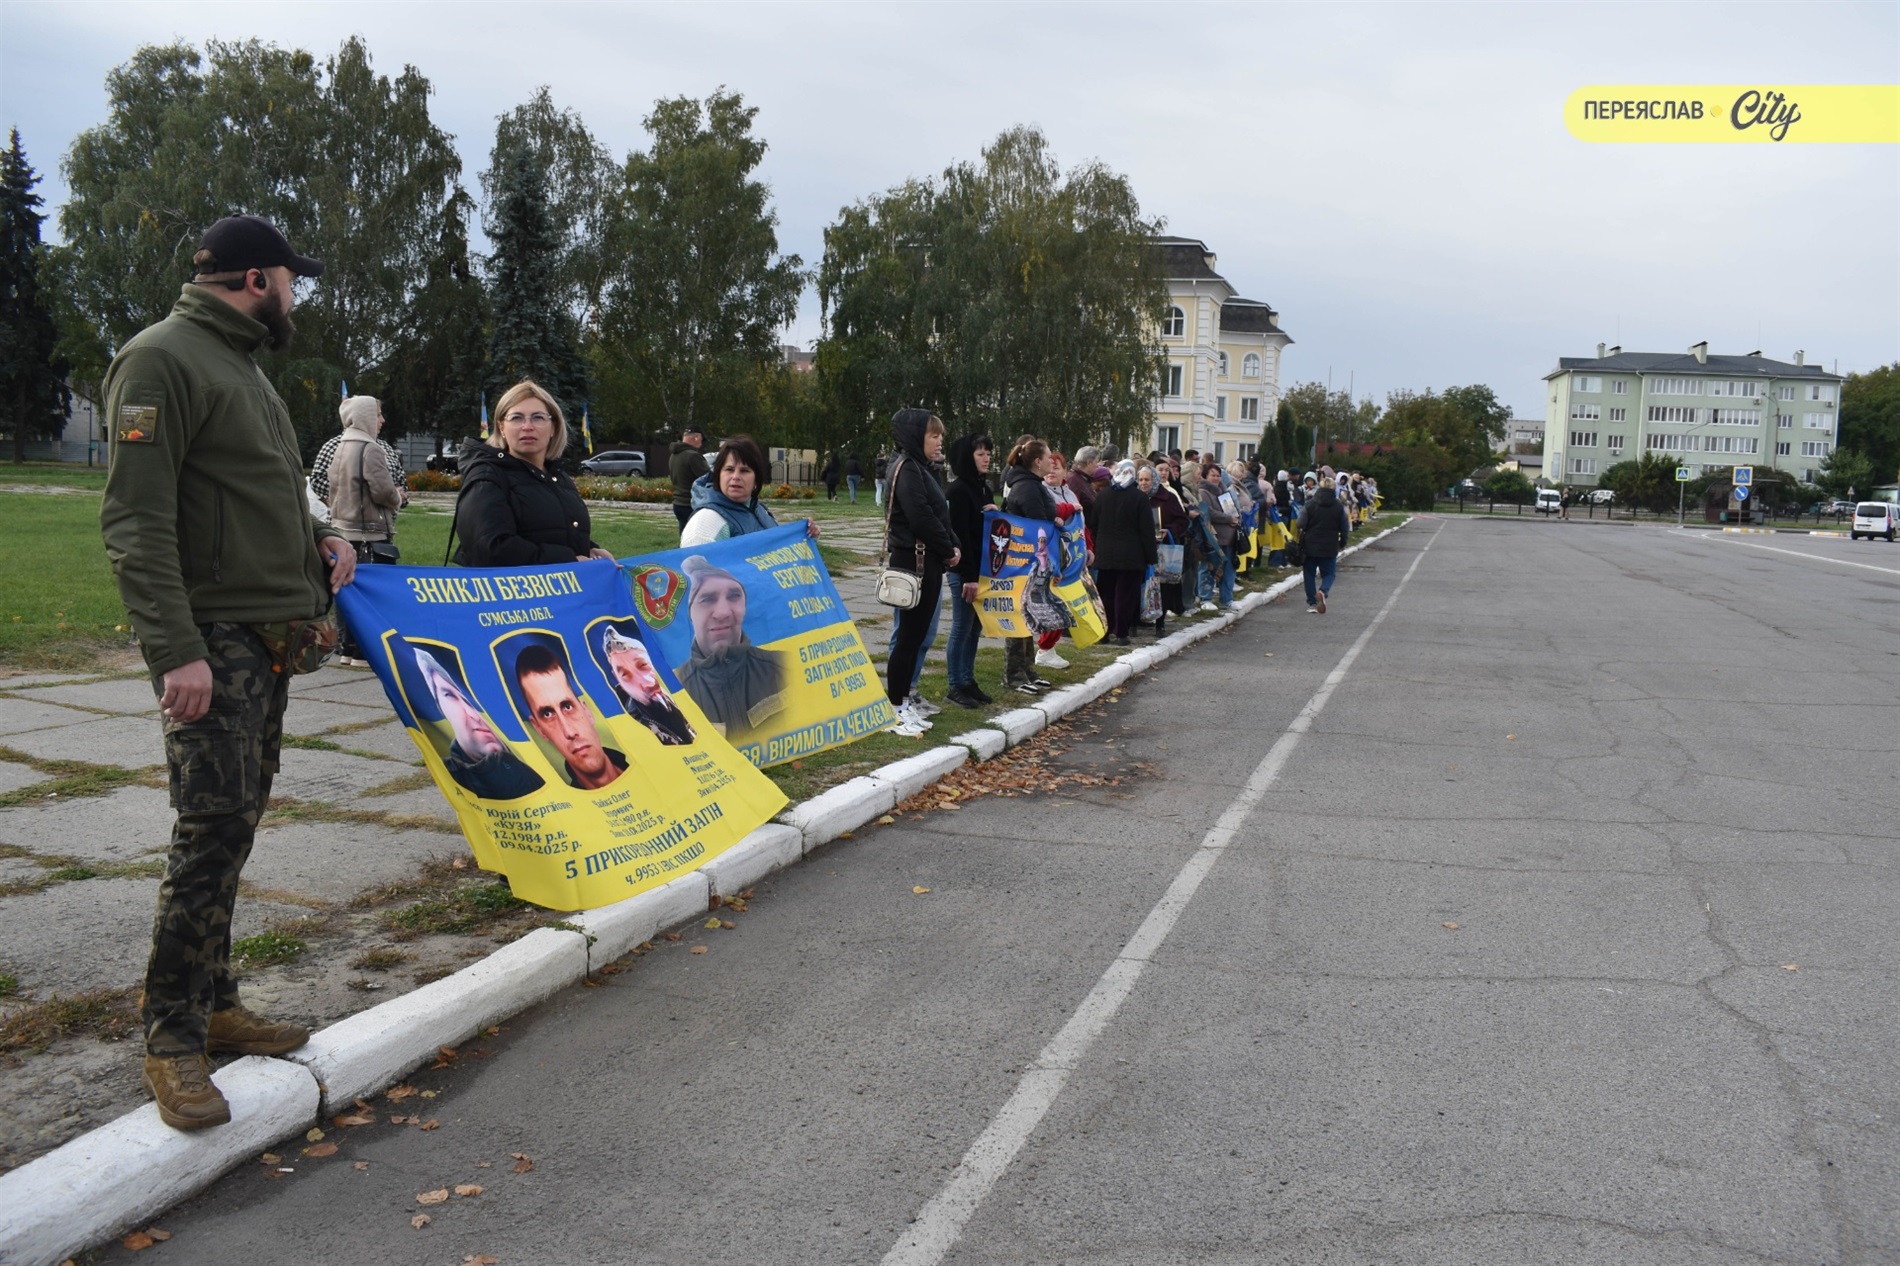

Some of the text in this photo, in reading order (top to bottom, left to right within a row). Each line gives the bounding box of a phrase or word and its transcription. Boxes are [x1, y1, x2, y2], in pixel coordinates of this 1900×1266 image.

[406, 571, 583, 603] ЗНИКЛІ БЕЗВІСТИ
[478, 609, 530, 627] СУМСЬКА
[799, 647, 808, 663] 5
[804, 661, 833, 684] ЗАГІН
[844, 672, 867, 692] 9953
[741, 745, 765, 767] СЯ,
[769, 725, 825, 762] ВІРИМО
[826, 719, 846, 742] ТА
[611, 790, 631, 803] Олег
[486, 808, 520, 819] Юрій
[657, 814, 666, 824] р.
[493, 820, 541, 832] «КУЗЯ»
[500, 840, 582, 855] 09.04.2025 р.
[565, 860, 578, 879] 5
[585, 820, 688, 876] ПРИКОРДОННИЙ
[684, 802, 724, 834] ЗАГІН
[635, 862, 660, 882] 9953
[674, 841, 705, 865] ПКШО
